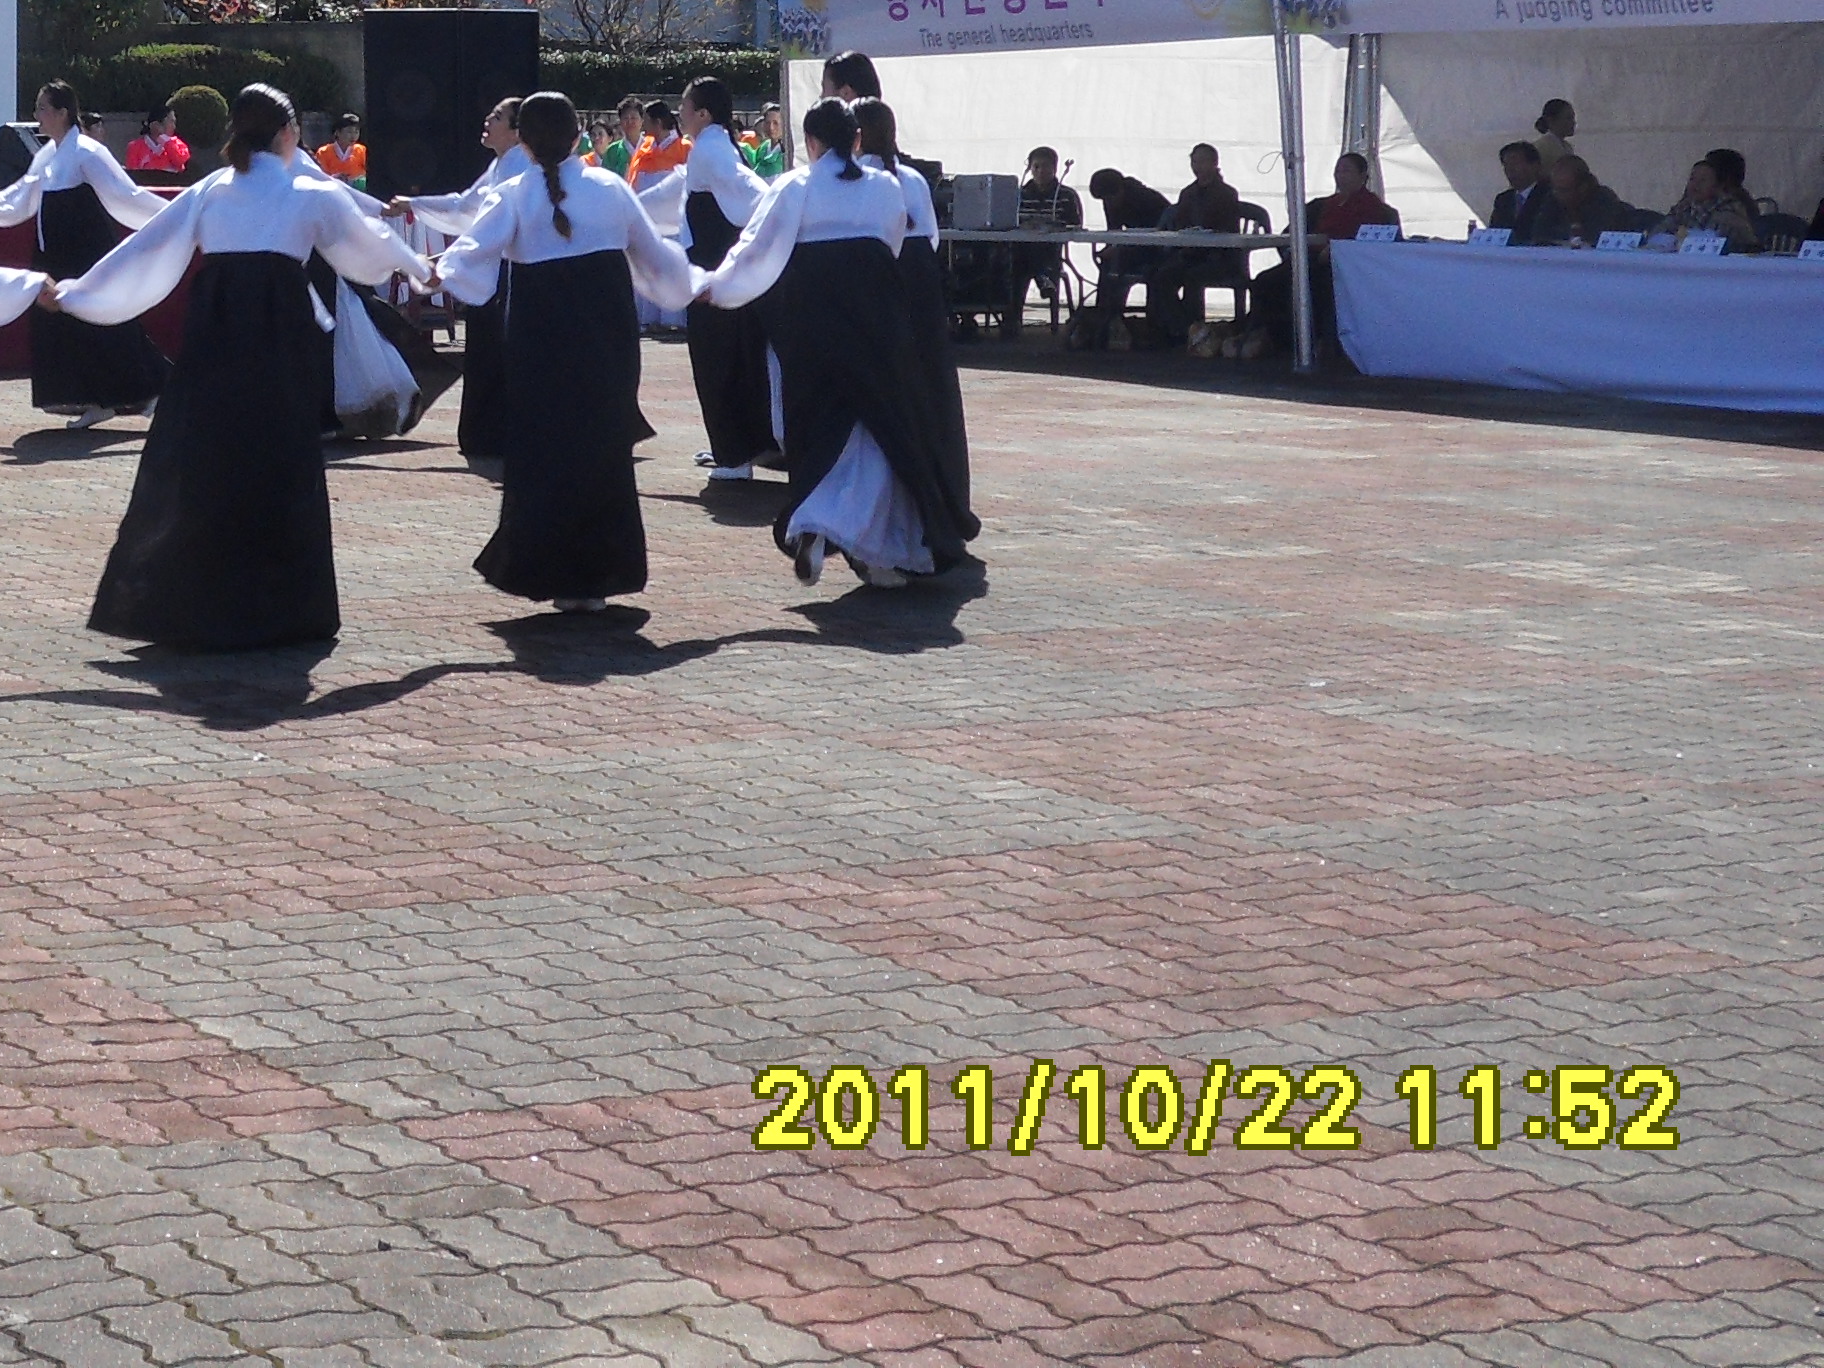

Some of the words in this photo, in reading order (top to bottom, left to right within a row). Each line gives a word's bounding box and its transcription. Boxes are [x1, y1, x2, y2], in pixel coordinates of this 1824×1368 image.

[919, 28, 943, 49] The
[947, 25, 997, 48] general
[1000, 21, 1094, 44] headquarters
